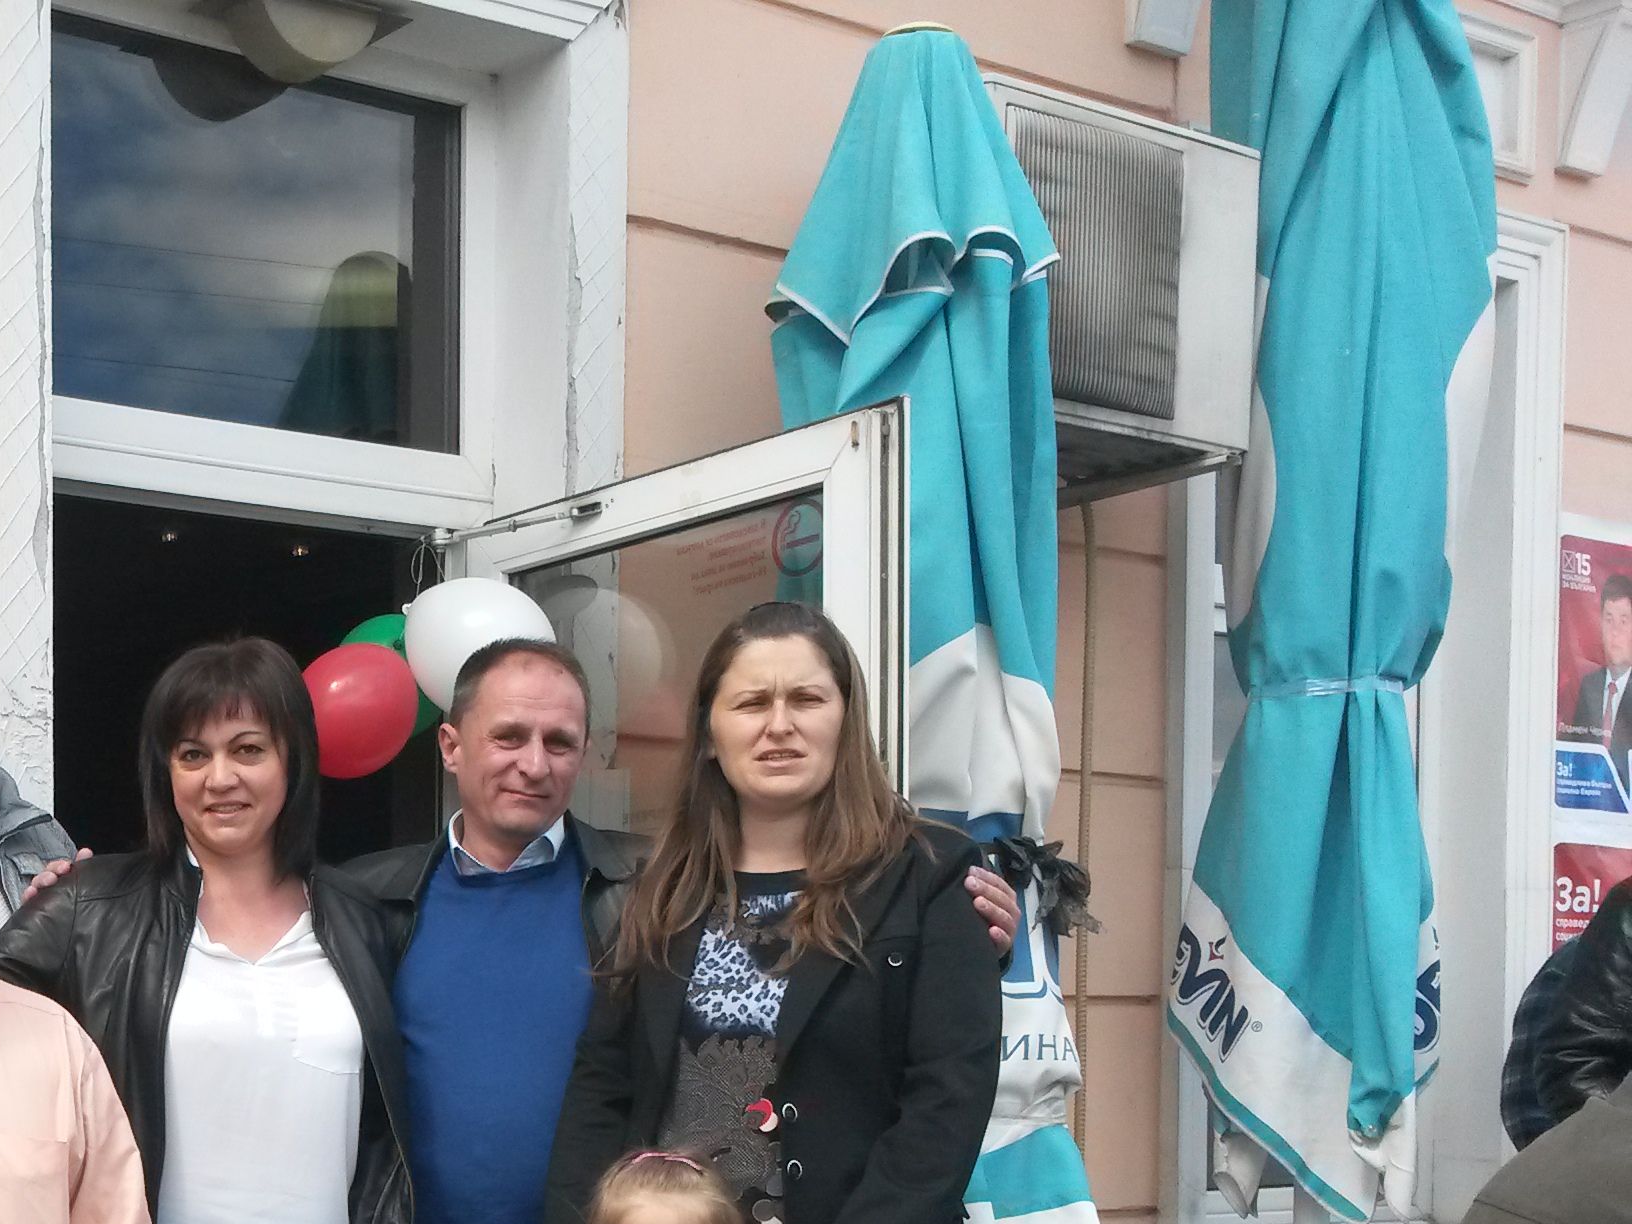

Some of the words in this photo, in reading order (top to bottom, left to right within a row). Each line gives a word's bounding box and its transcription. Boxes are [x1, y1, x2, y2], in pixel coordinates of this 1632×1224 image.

[1575, 552, 1591, 576] 15
[1555, 876, 1601, 912] За!
[1001, 1033, 1078, 1062] ИНА
